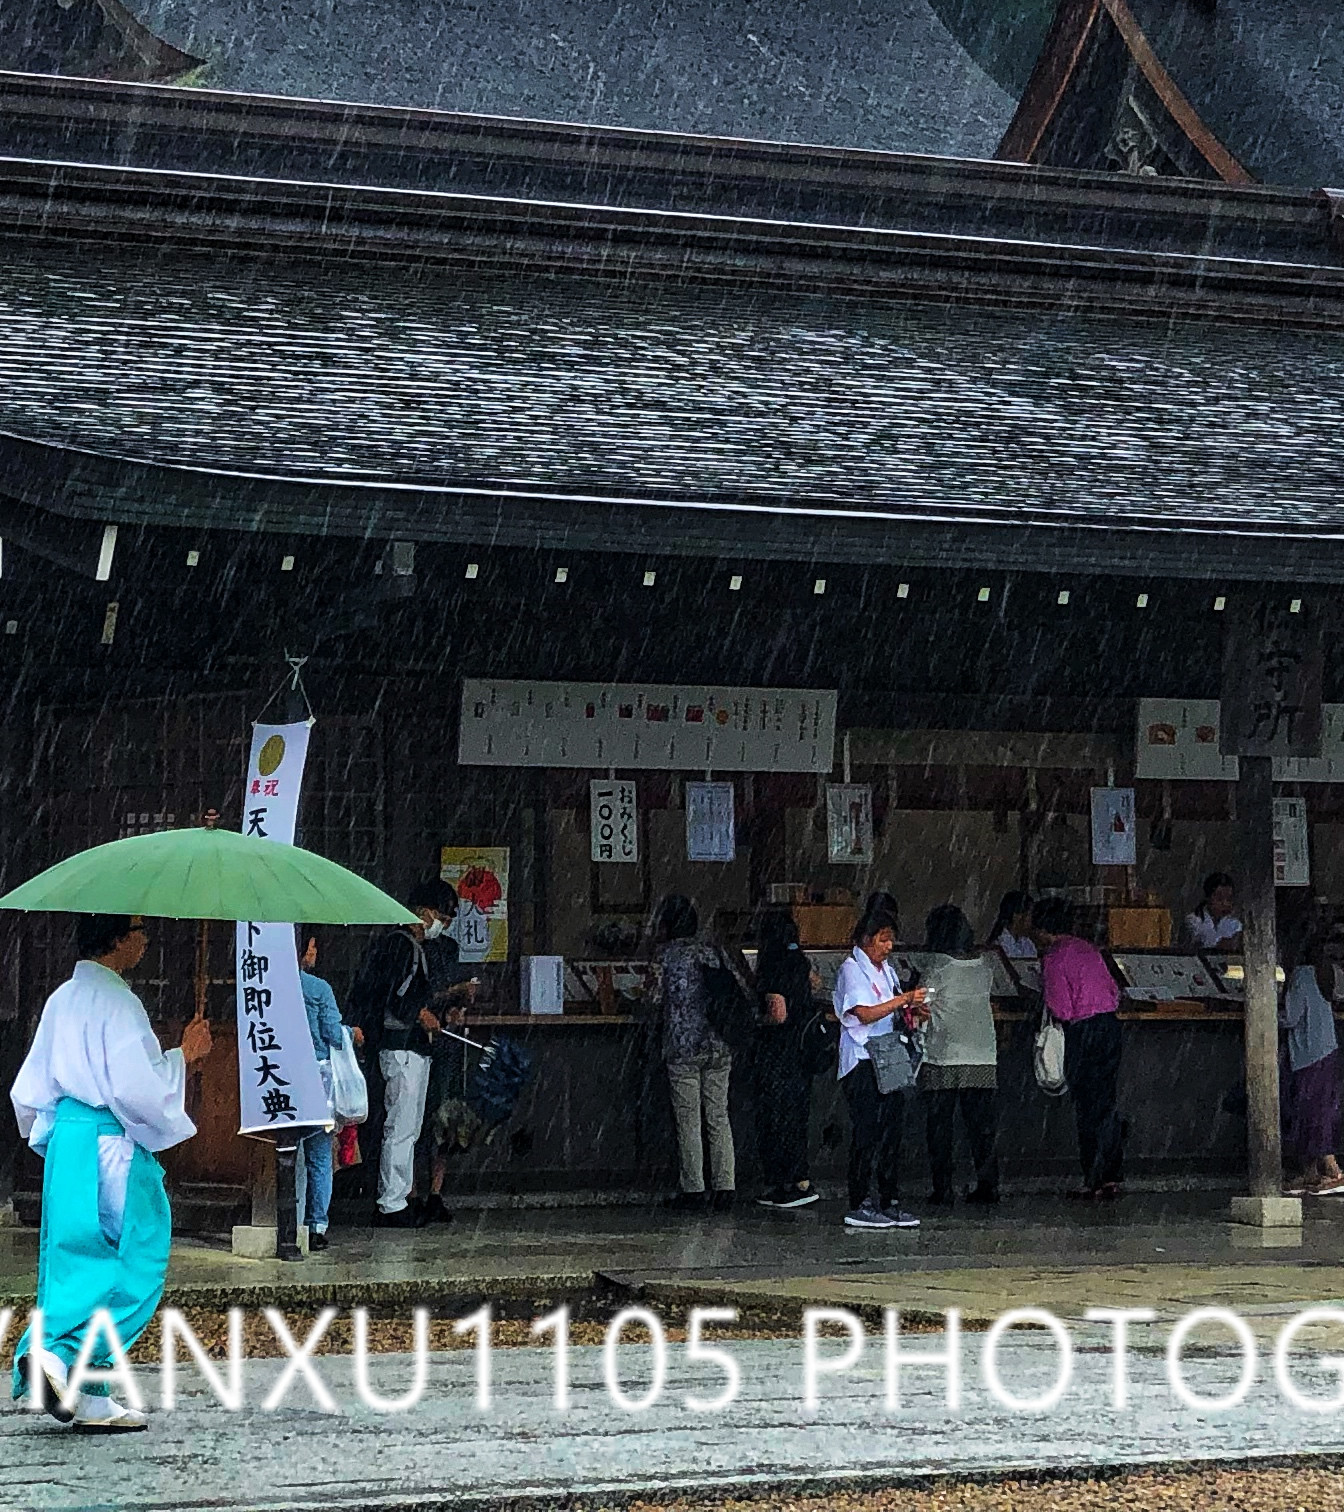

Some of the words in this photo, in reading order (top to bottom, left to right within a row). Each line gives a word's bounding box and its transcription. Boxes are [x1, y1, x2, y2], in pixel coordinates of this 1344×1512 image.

[250, 779, 279, 797] 奉祝
[619, 786, 633, 856] おみくじ
